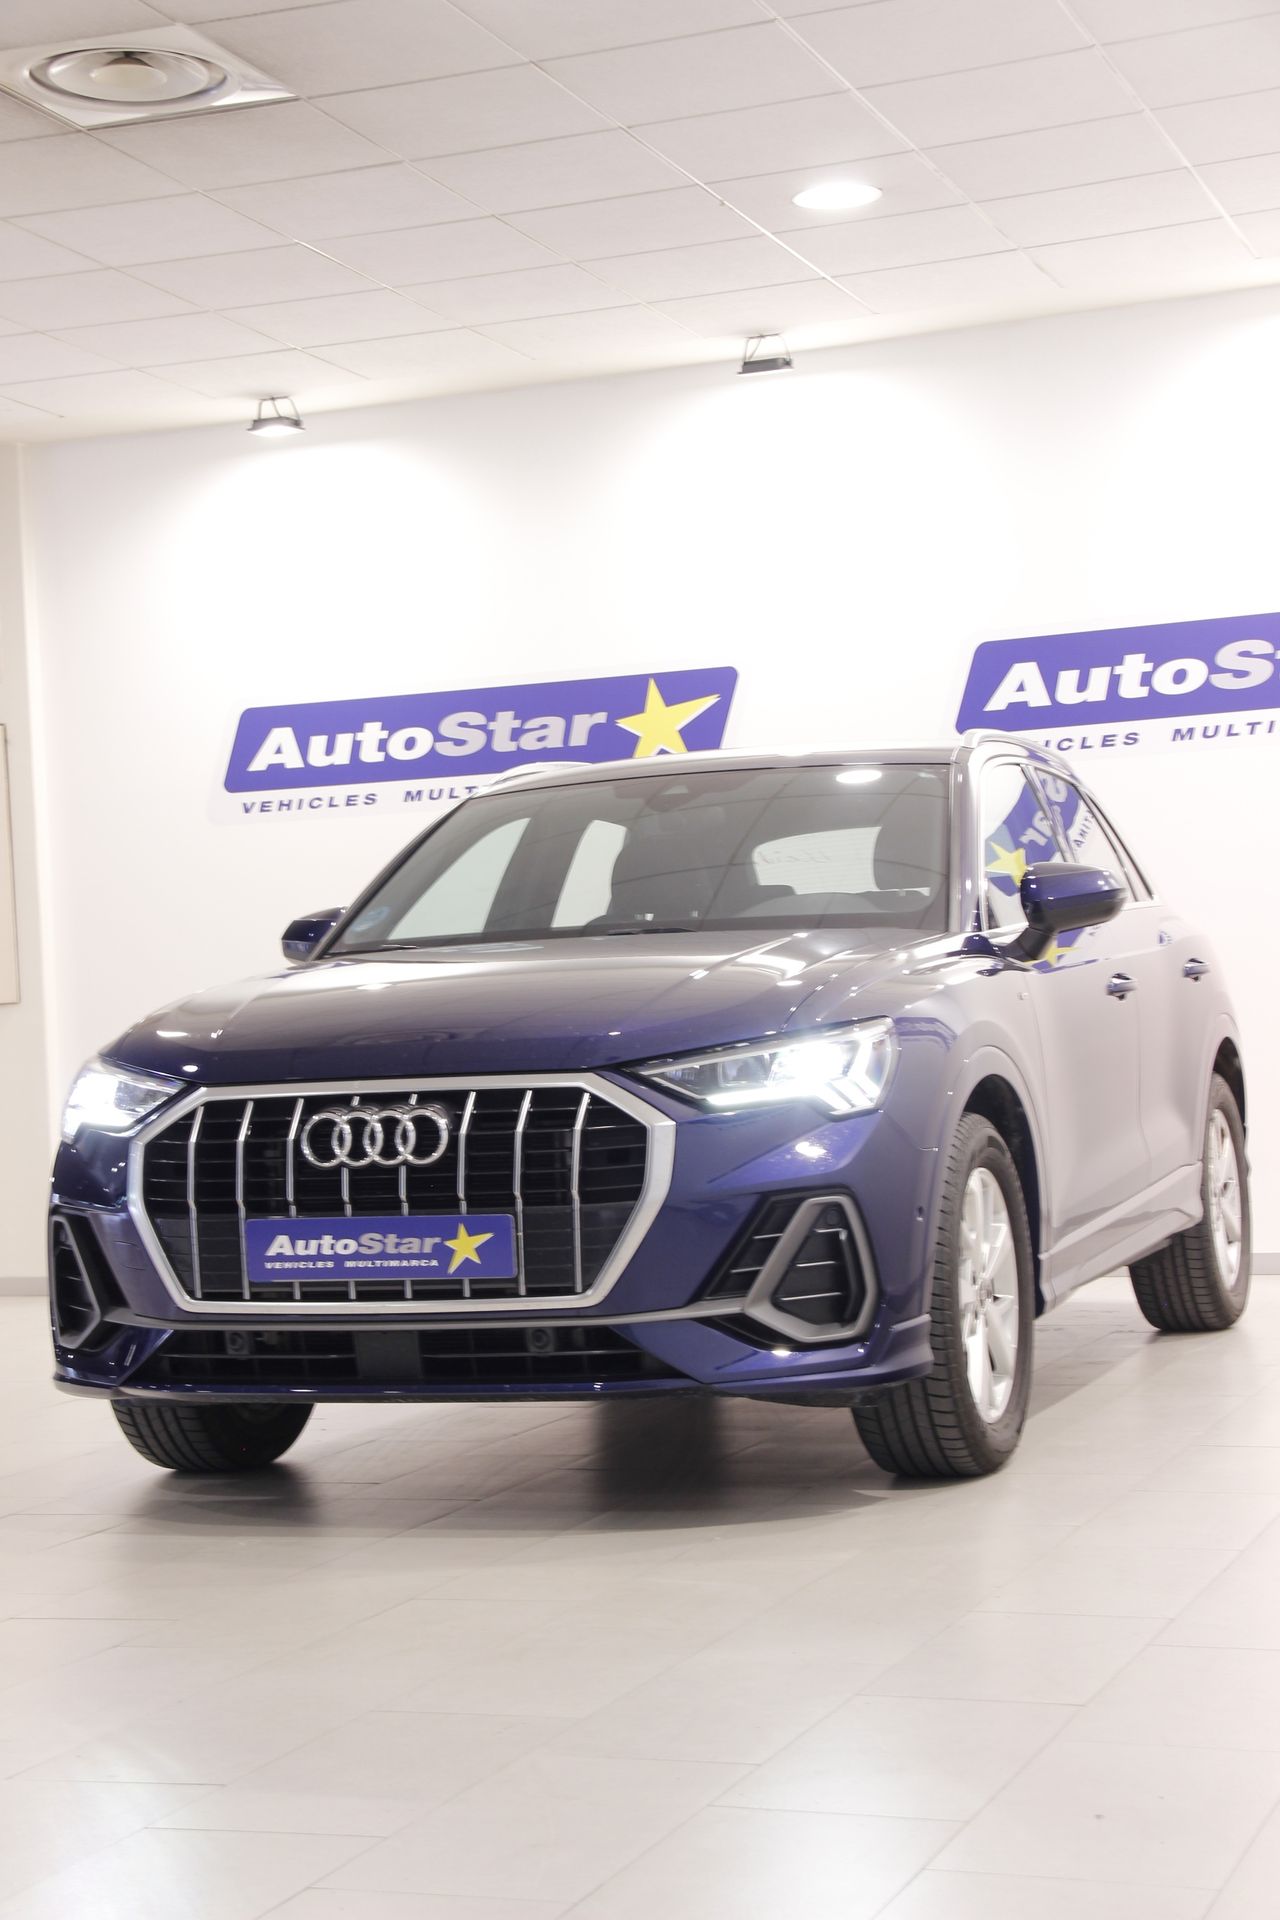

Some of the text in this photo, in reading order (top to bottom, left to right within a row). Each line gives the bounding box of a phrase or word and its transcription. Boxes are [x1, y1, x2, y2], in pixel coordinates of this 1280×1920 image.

[983, 639, 1280, 712] AutoS
[246, 710, 609, 773] AutoStar
[242, 792, 379, 814] VEHICLES
[264, 1232, 442, 1256] AutoStar
[264, 1258, 439, 1269] VEHICLES MULTIMARCA
